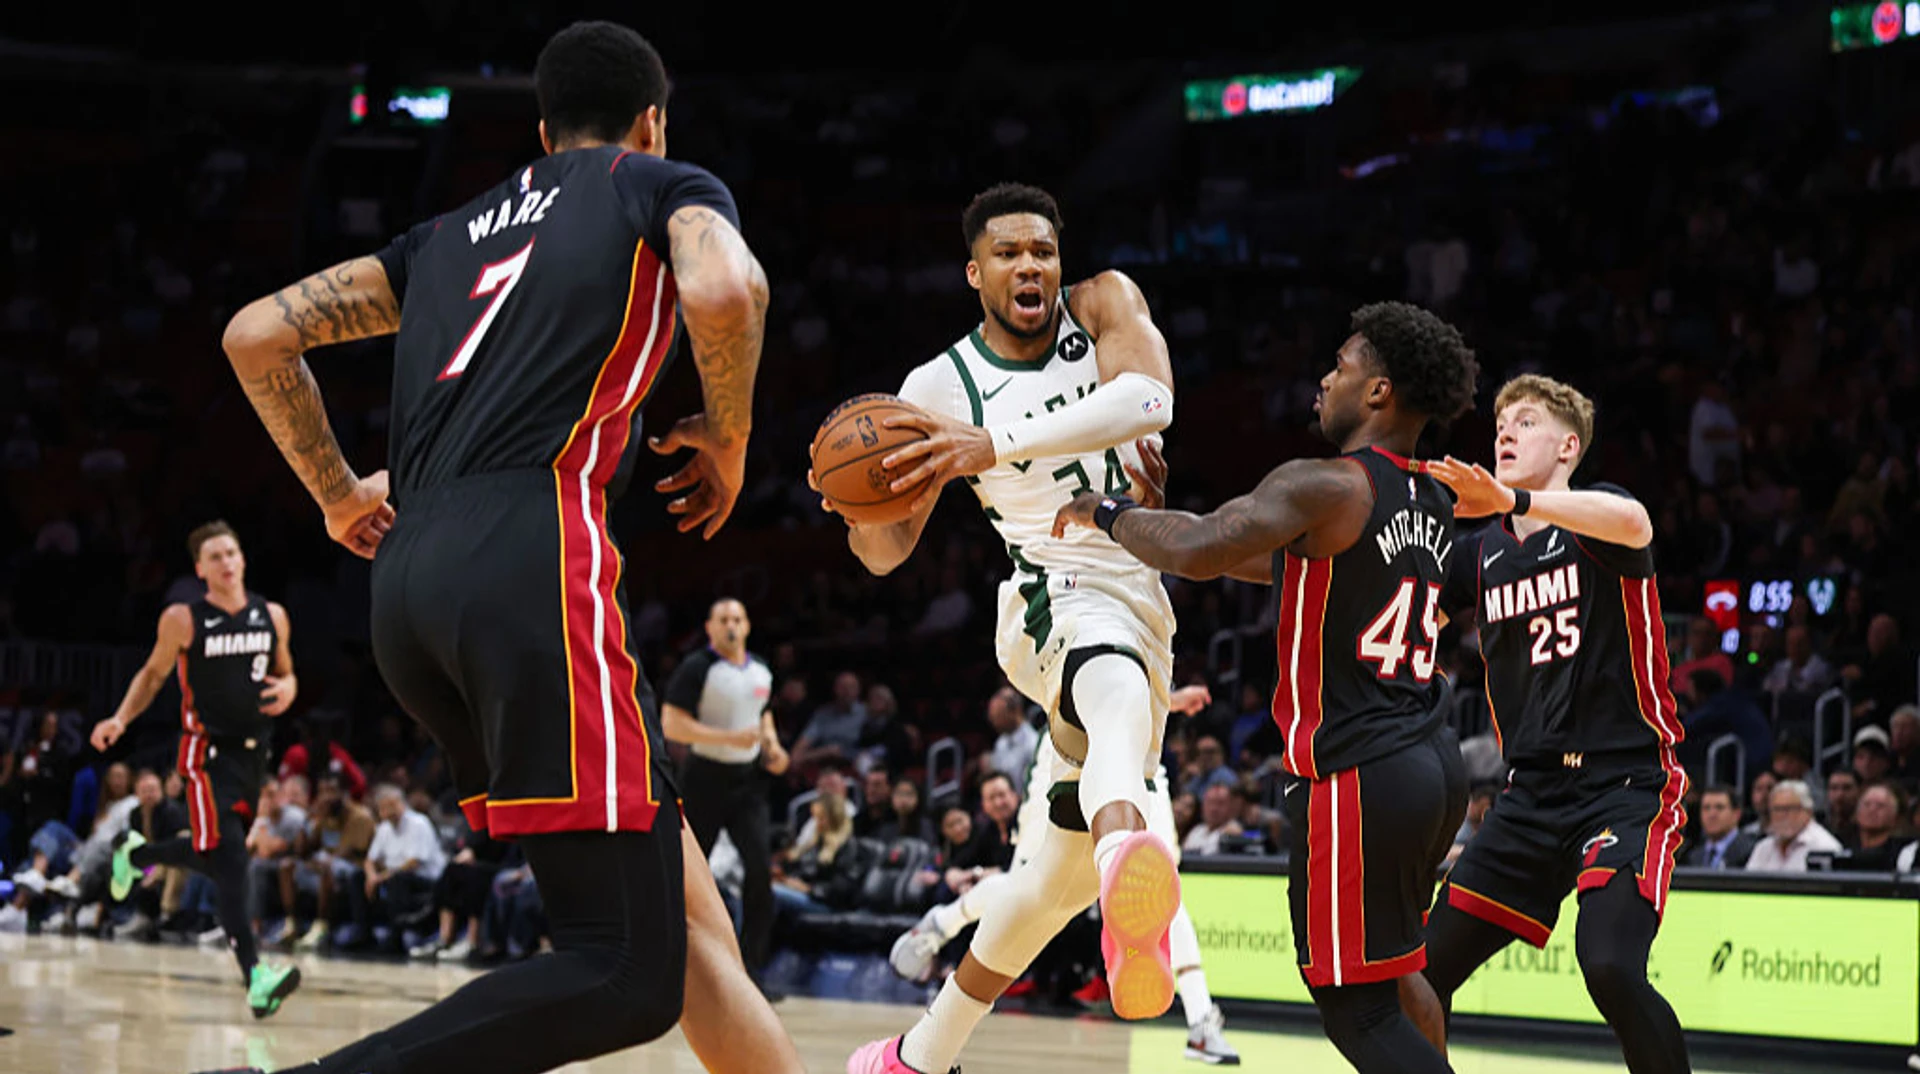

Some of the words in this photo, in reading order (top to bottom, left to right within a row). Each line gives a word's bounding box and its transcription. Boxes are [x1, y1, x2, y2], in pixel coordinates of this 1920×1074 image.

[467, 186, 561, 245] WARE
[438, 233, 536, 382] 7
[1376, 508, 1452, 574] MITCHELL
[1484, 563, 1580, 624] MIAMI
[204, 631, 272, 658] MIAMI
[1356, 576, 1442, 684] 45
[1528, 605, 1581, 667] 25
[250, 653, 269, 682] 9
[1197, 923, 1288, 954] obinhood
[1741, 948, 1881, 987] Robinhood
